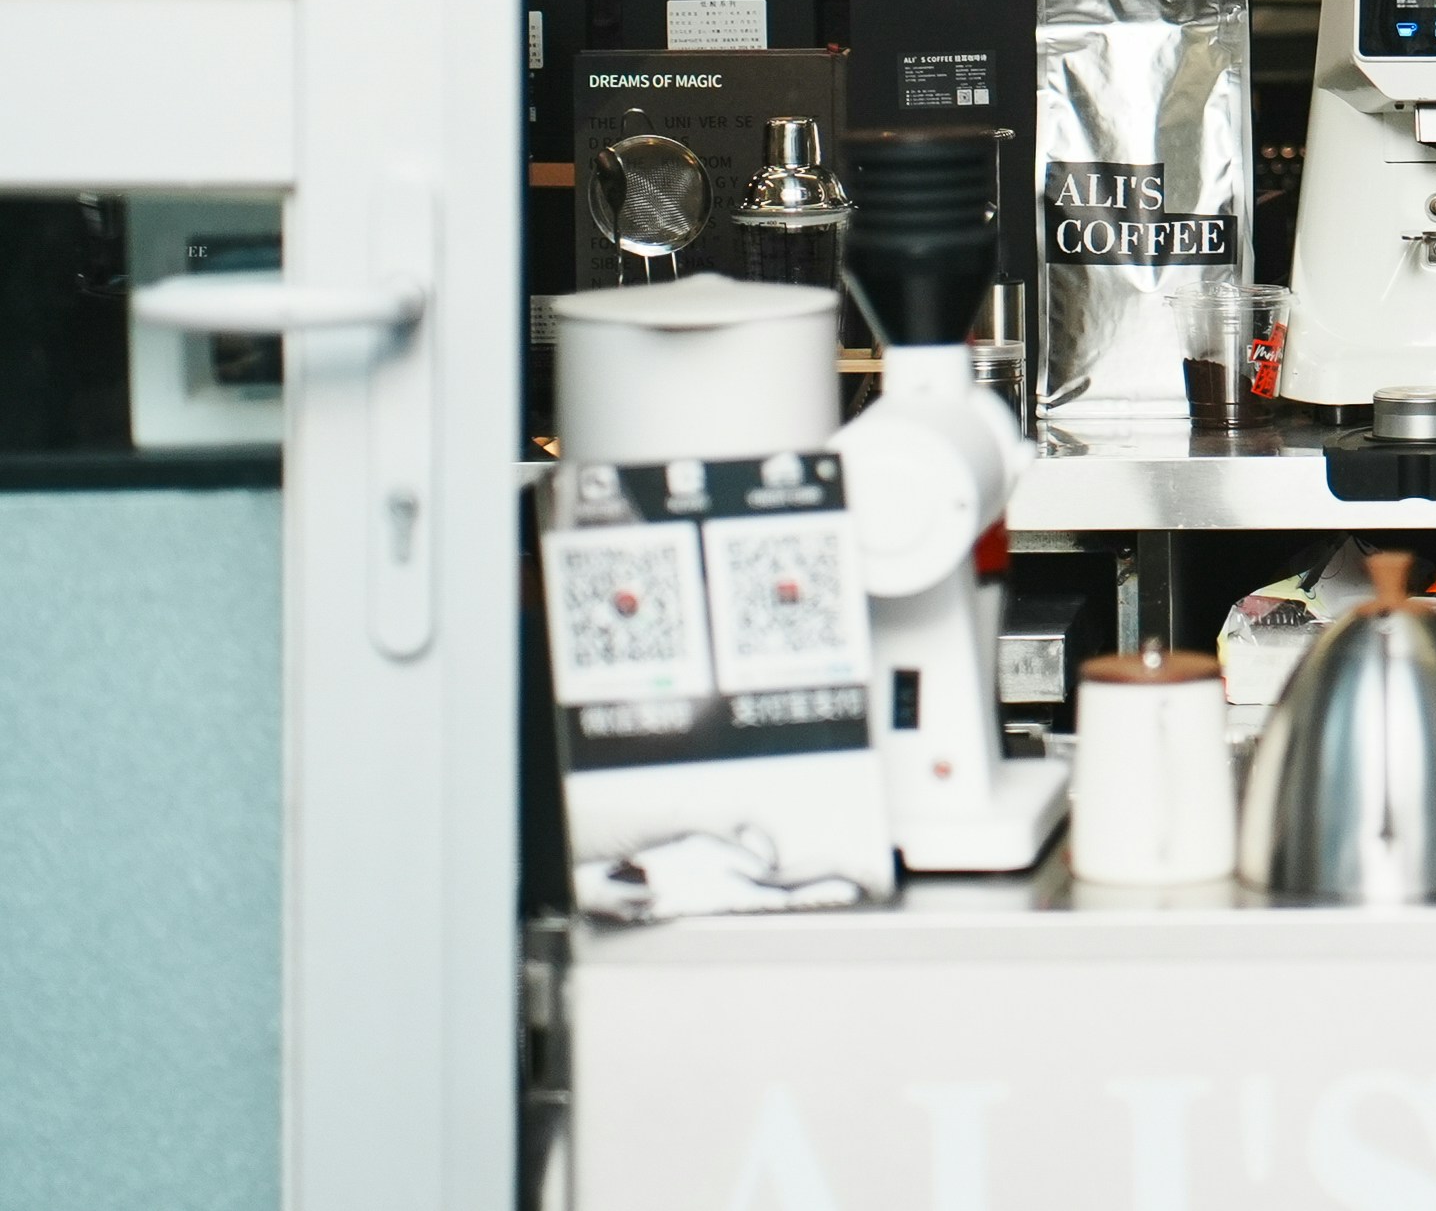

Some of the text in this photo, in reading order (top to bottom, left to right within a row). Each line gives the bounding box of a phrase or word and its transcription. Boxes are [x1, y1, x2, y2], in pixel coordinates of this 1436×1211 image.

[589, 74, 722, 88] DREAMS OF MAGIC
[1055, 173, 1163, 211] ALI'S
[1056, 218, 1226, 255] COFFEE
